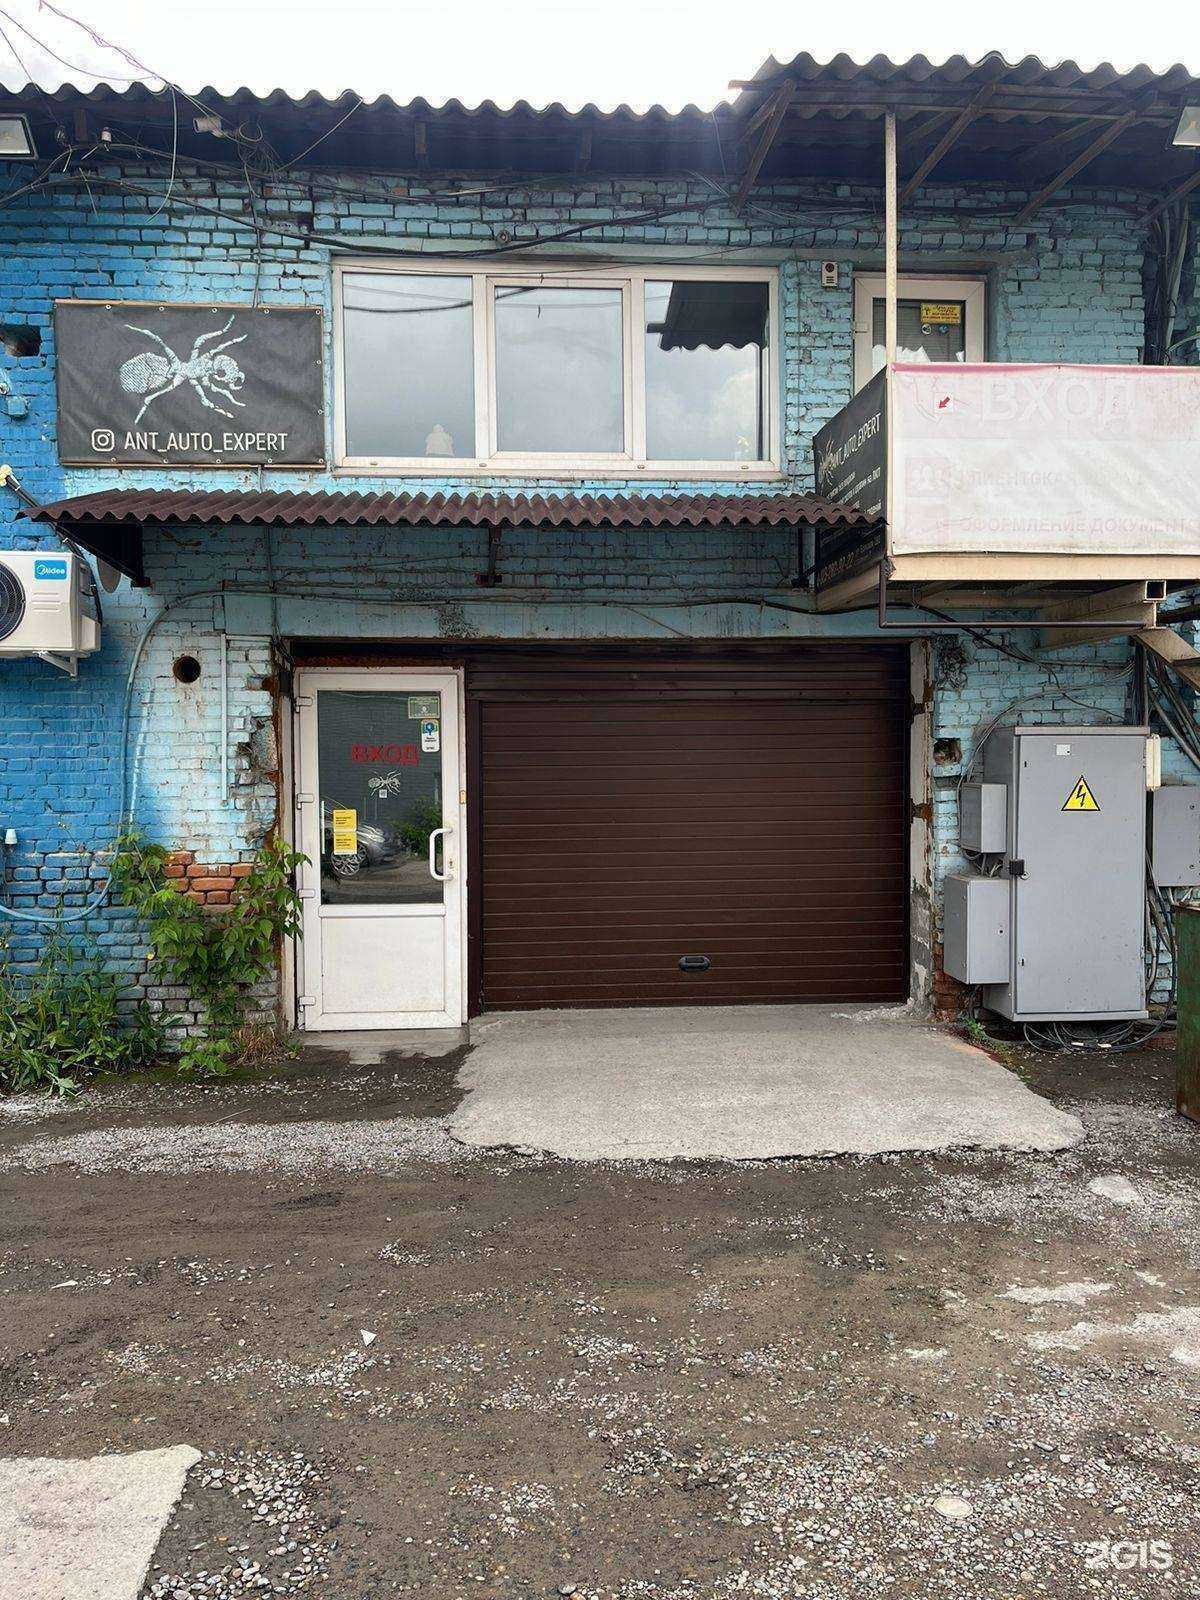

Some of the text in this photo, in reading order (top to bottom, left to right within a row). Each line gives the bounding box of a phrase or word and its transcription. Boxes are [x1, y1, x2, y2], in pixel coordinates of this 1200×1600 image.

[982, 376, 1138, 424] ВХОД
[124, 431, 288, 453] ANT_AUTO_EXPERT
[38, 564, 65, 575] Midea
[352, 743, 419, 767] ВХОД
